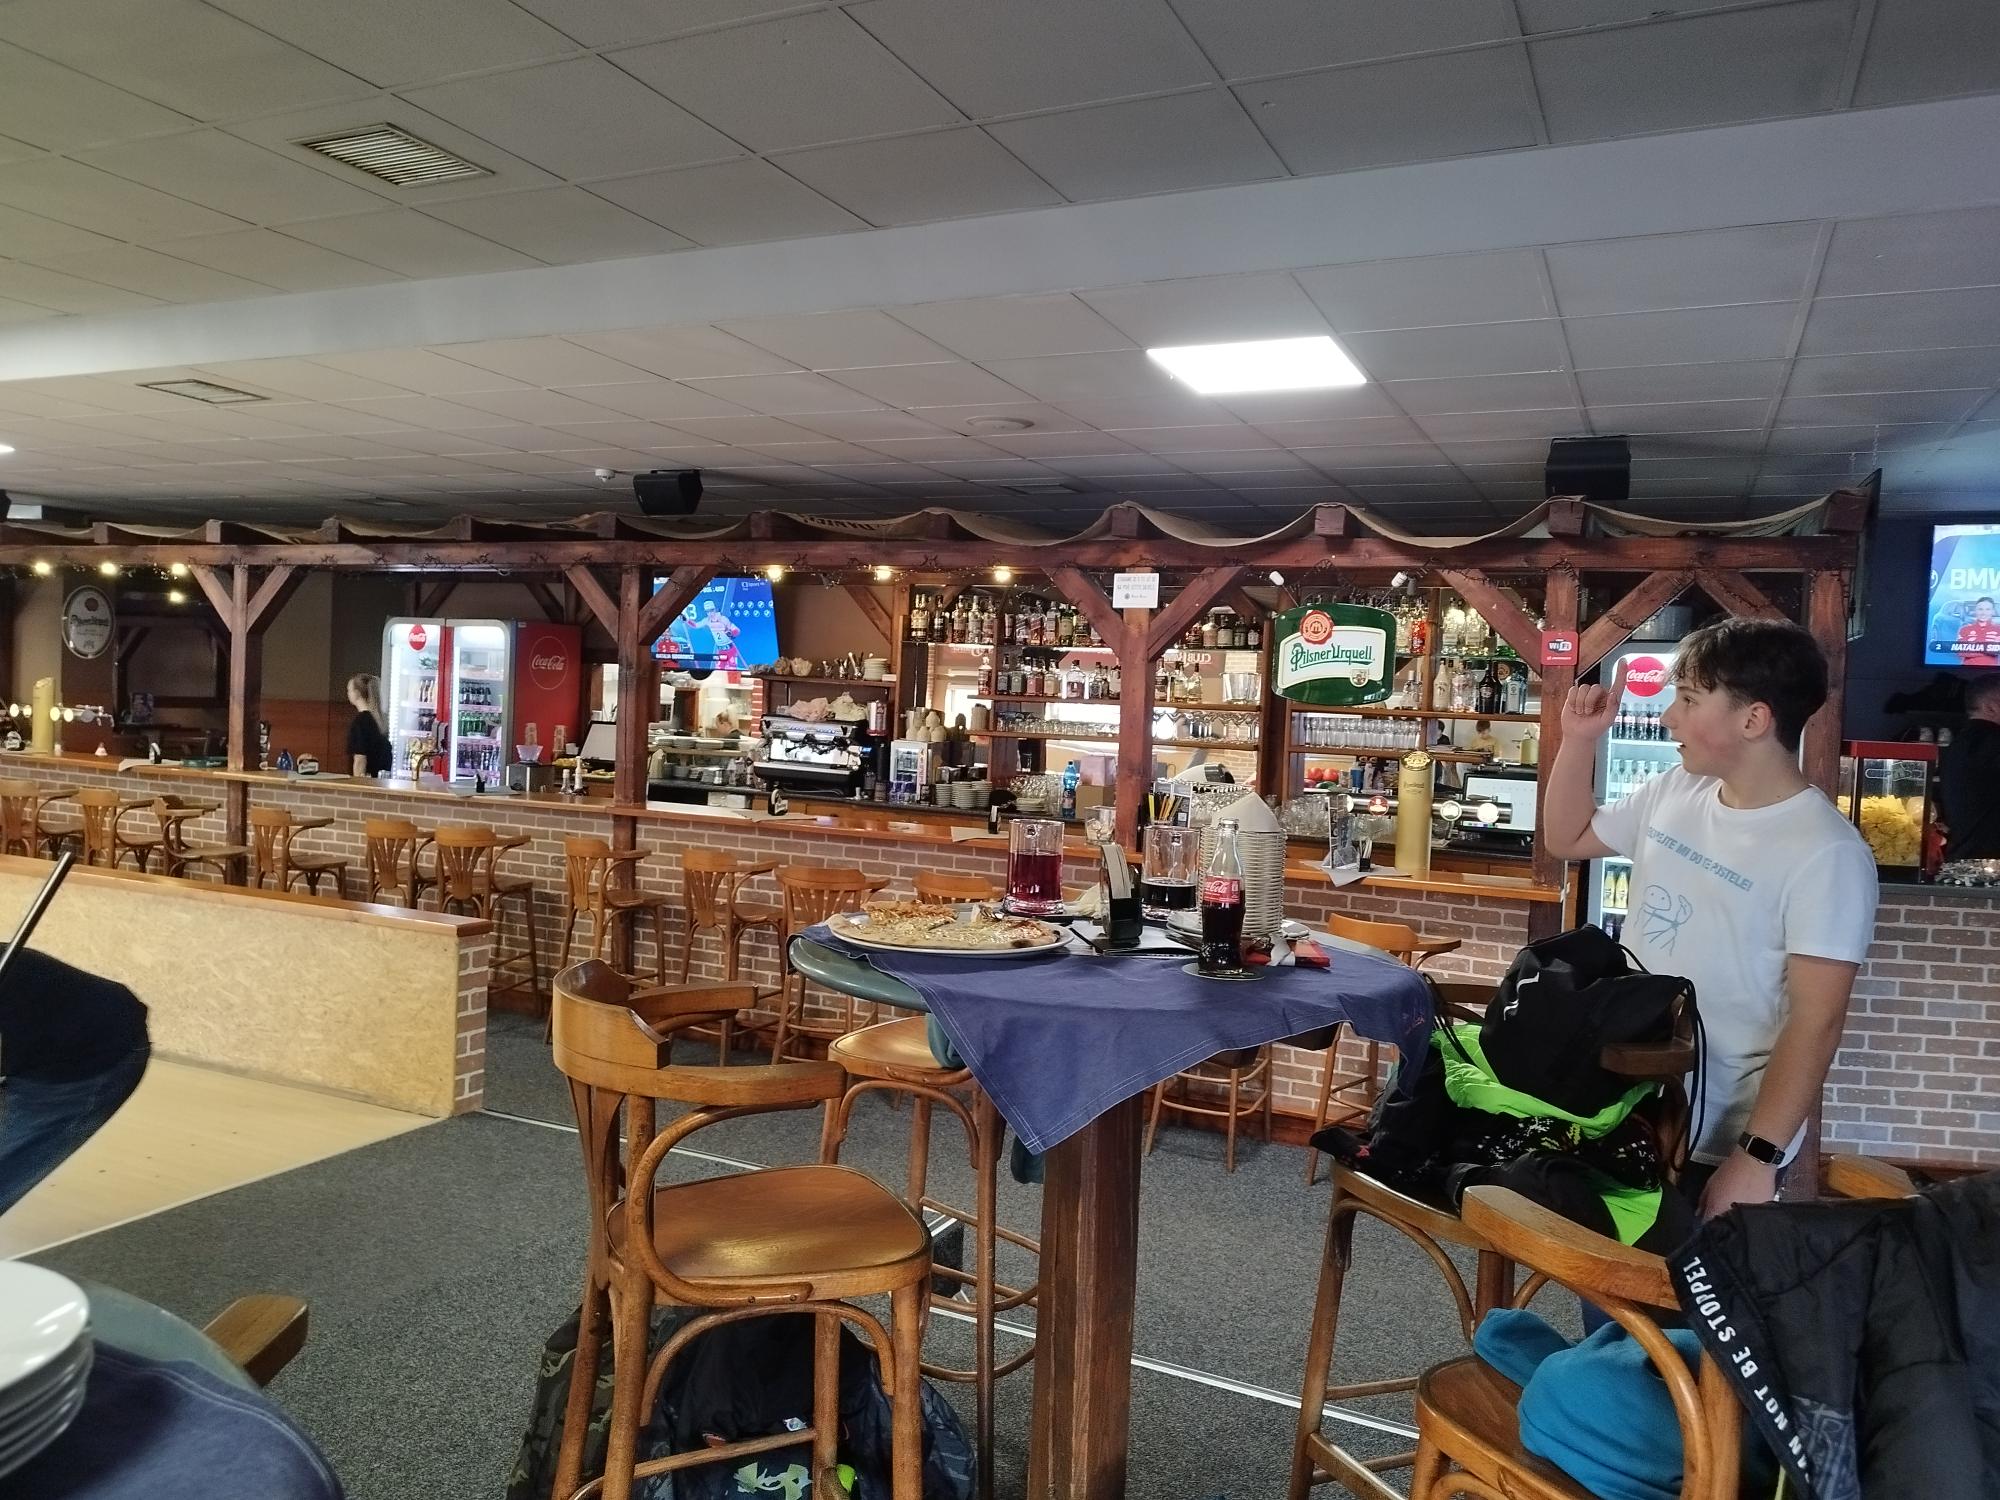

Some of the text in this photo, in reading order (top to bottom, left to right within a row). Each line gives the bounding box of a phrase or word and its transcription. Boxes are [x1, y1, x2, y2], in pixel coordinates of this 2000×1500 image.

[1290, 643, 1372, 672] Pilsner Urquell
[1732, 1346, 1759, 1379] BE
[1754, 1384, 1789, 1431] NOT
[1788, 1435, 1810, 1484] AN
